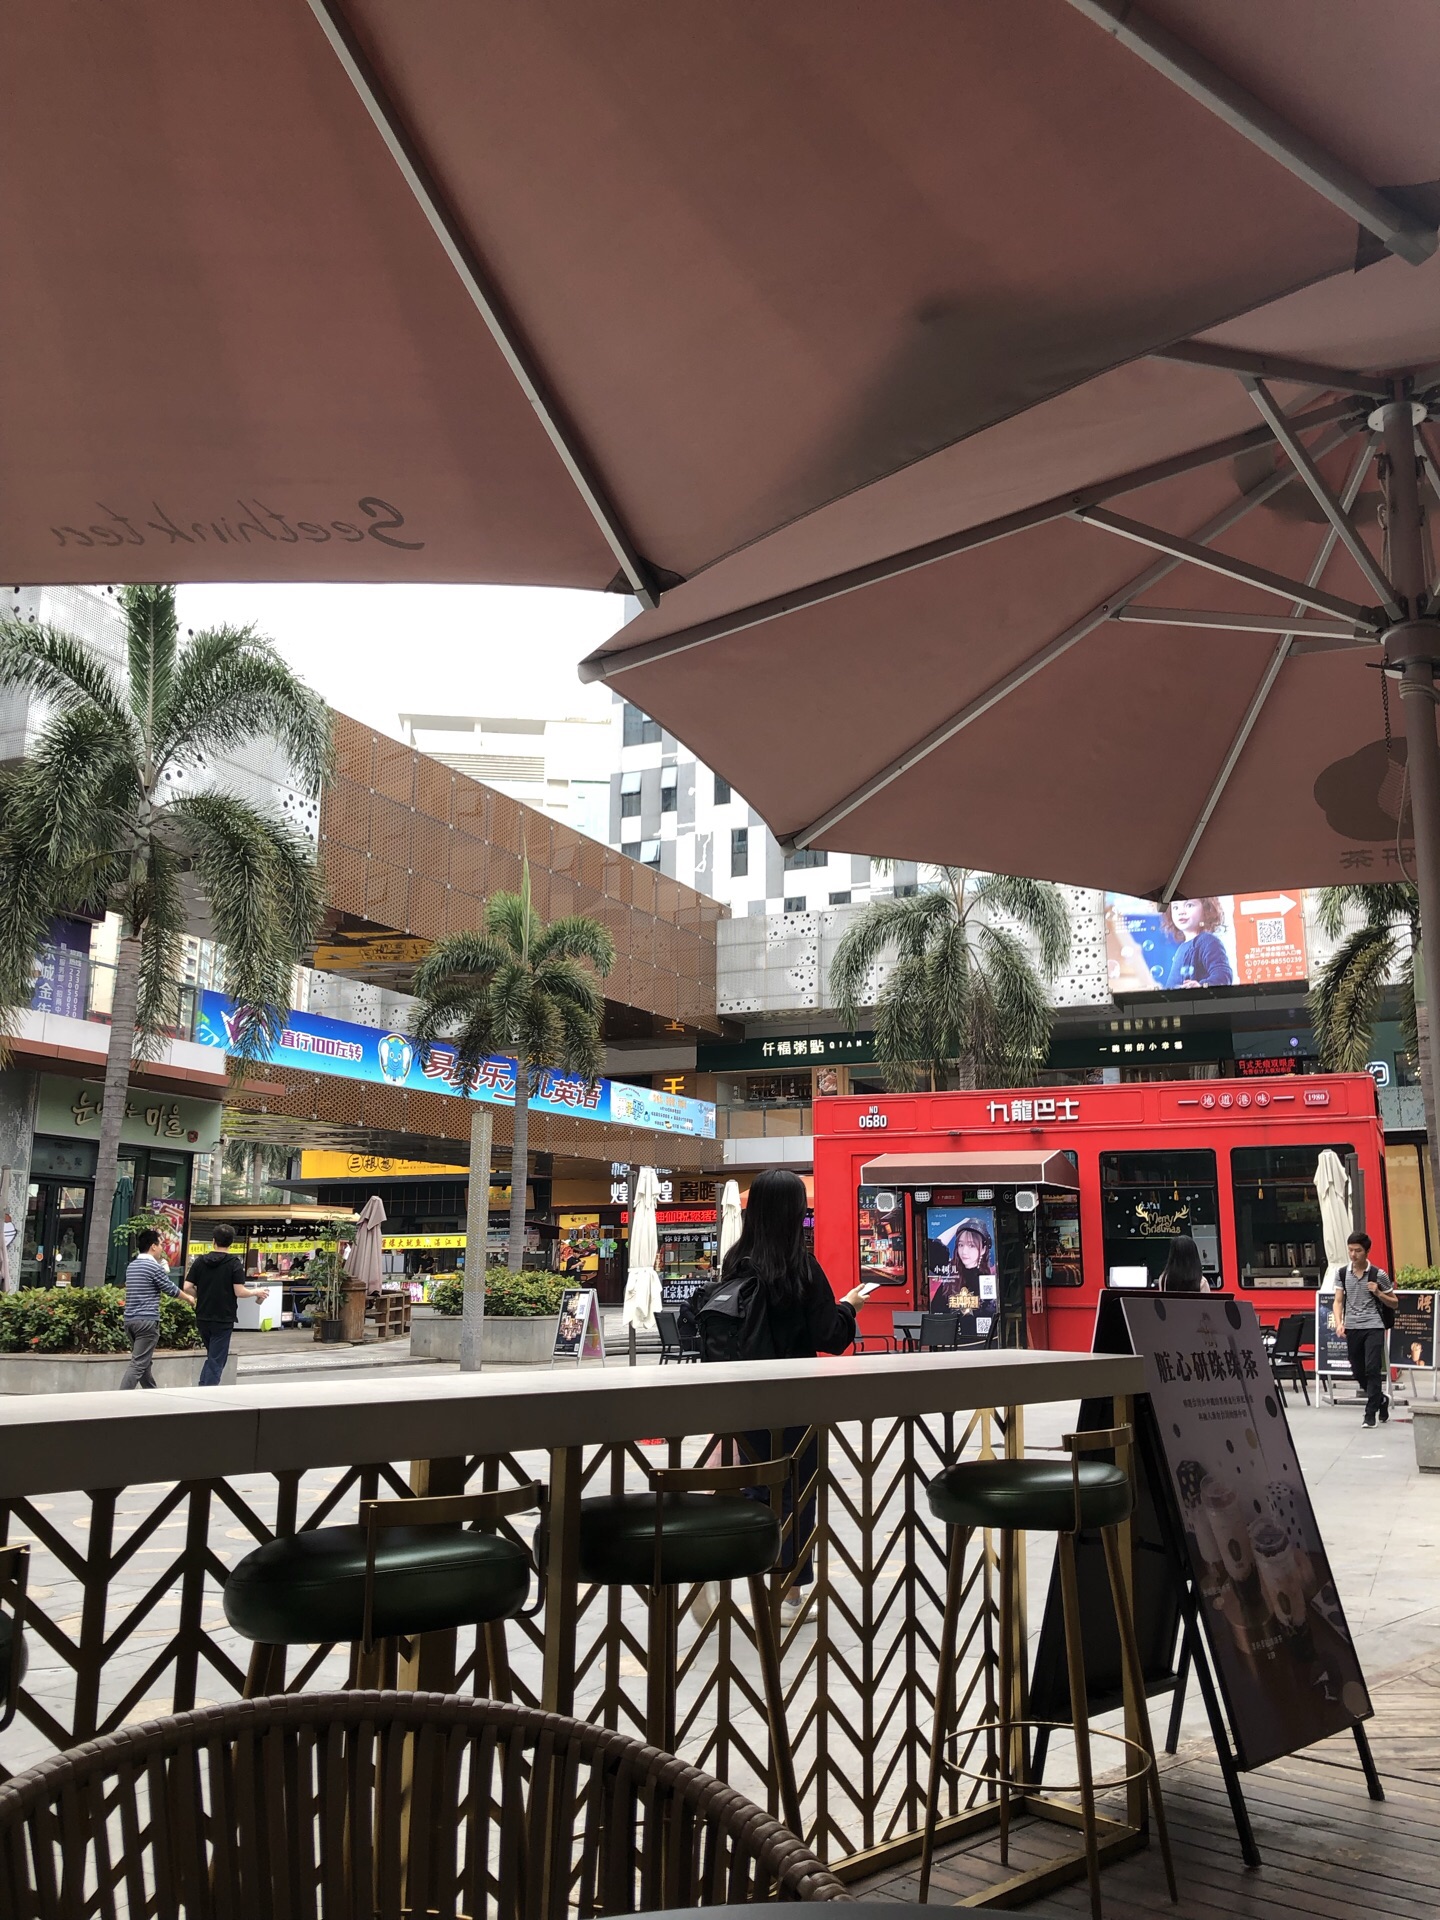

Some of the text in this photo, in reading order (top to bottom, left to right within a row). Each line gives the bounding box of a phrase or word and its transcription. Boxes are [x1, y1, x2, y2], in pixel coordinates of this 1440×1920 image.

[280, 1028, 363, 1062] 直行100左转
[1307, 1093, 1325, 1101] 1980
[868, 1105, 879, 1114] NO
[986, 1098, 1080, 1123] 九龍巴士
[858, 1115, 888, 1129] 0680
[1148, 1212, 1175, 1227] Merry
[1139, 1221, 1182, 1236] Christmas
